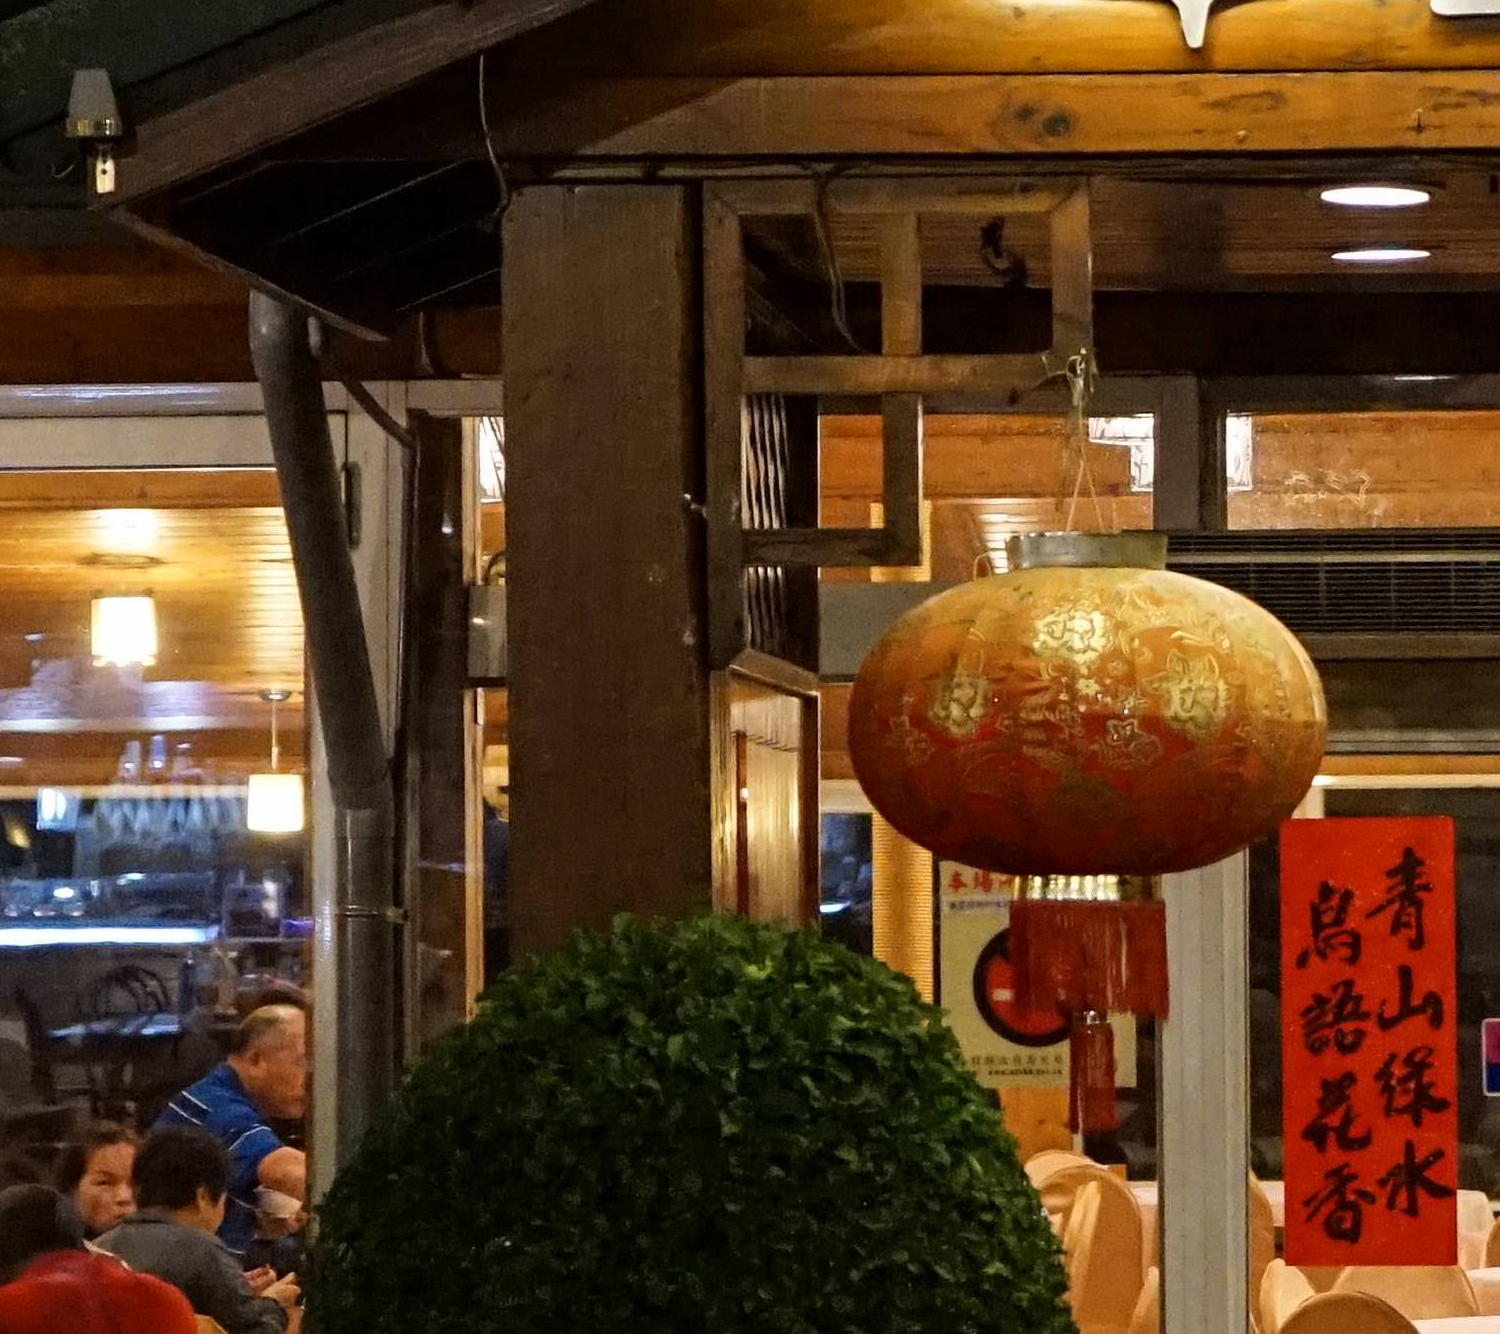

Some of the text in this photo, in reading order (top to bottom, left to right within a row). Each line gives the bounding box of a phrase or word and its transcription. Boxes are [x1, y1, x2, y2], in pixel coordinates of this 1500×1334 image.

[1295, 880, 1376, 1244] 鳥語花香
[1365, 847, 1456, 1218] 青山綠水
